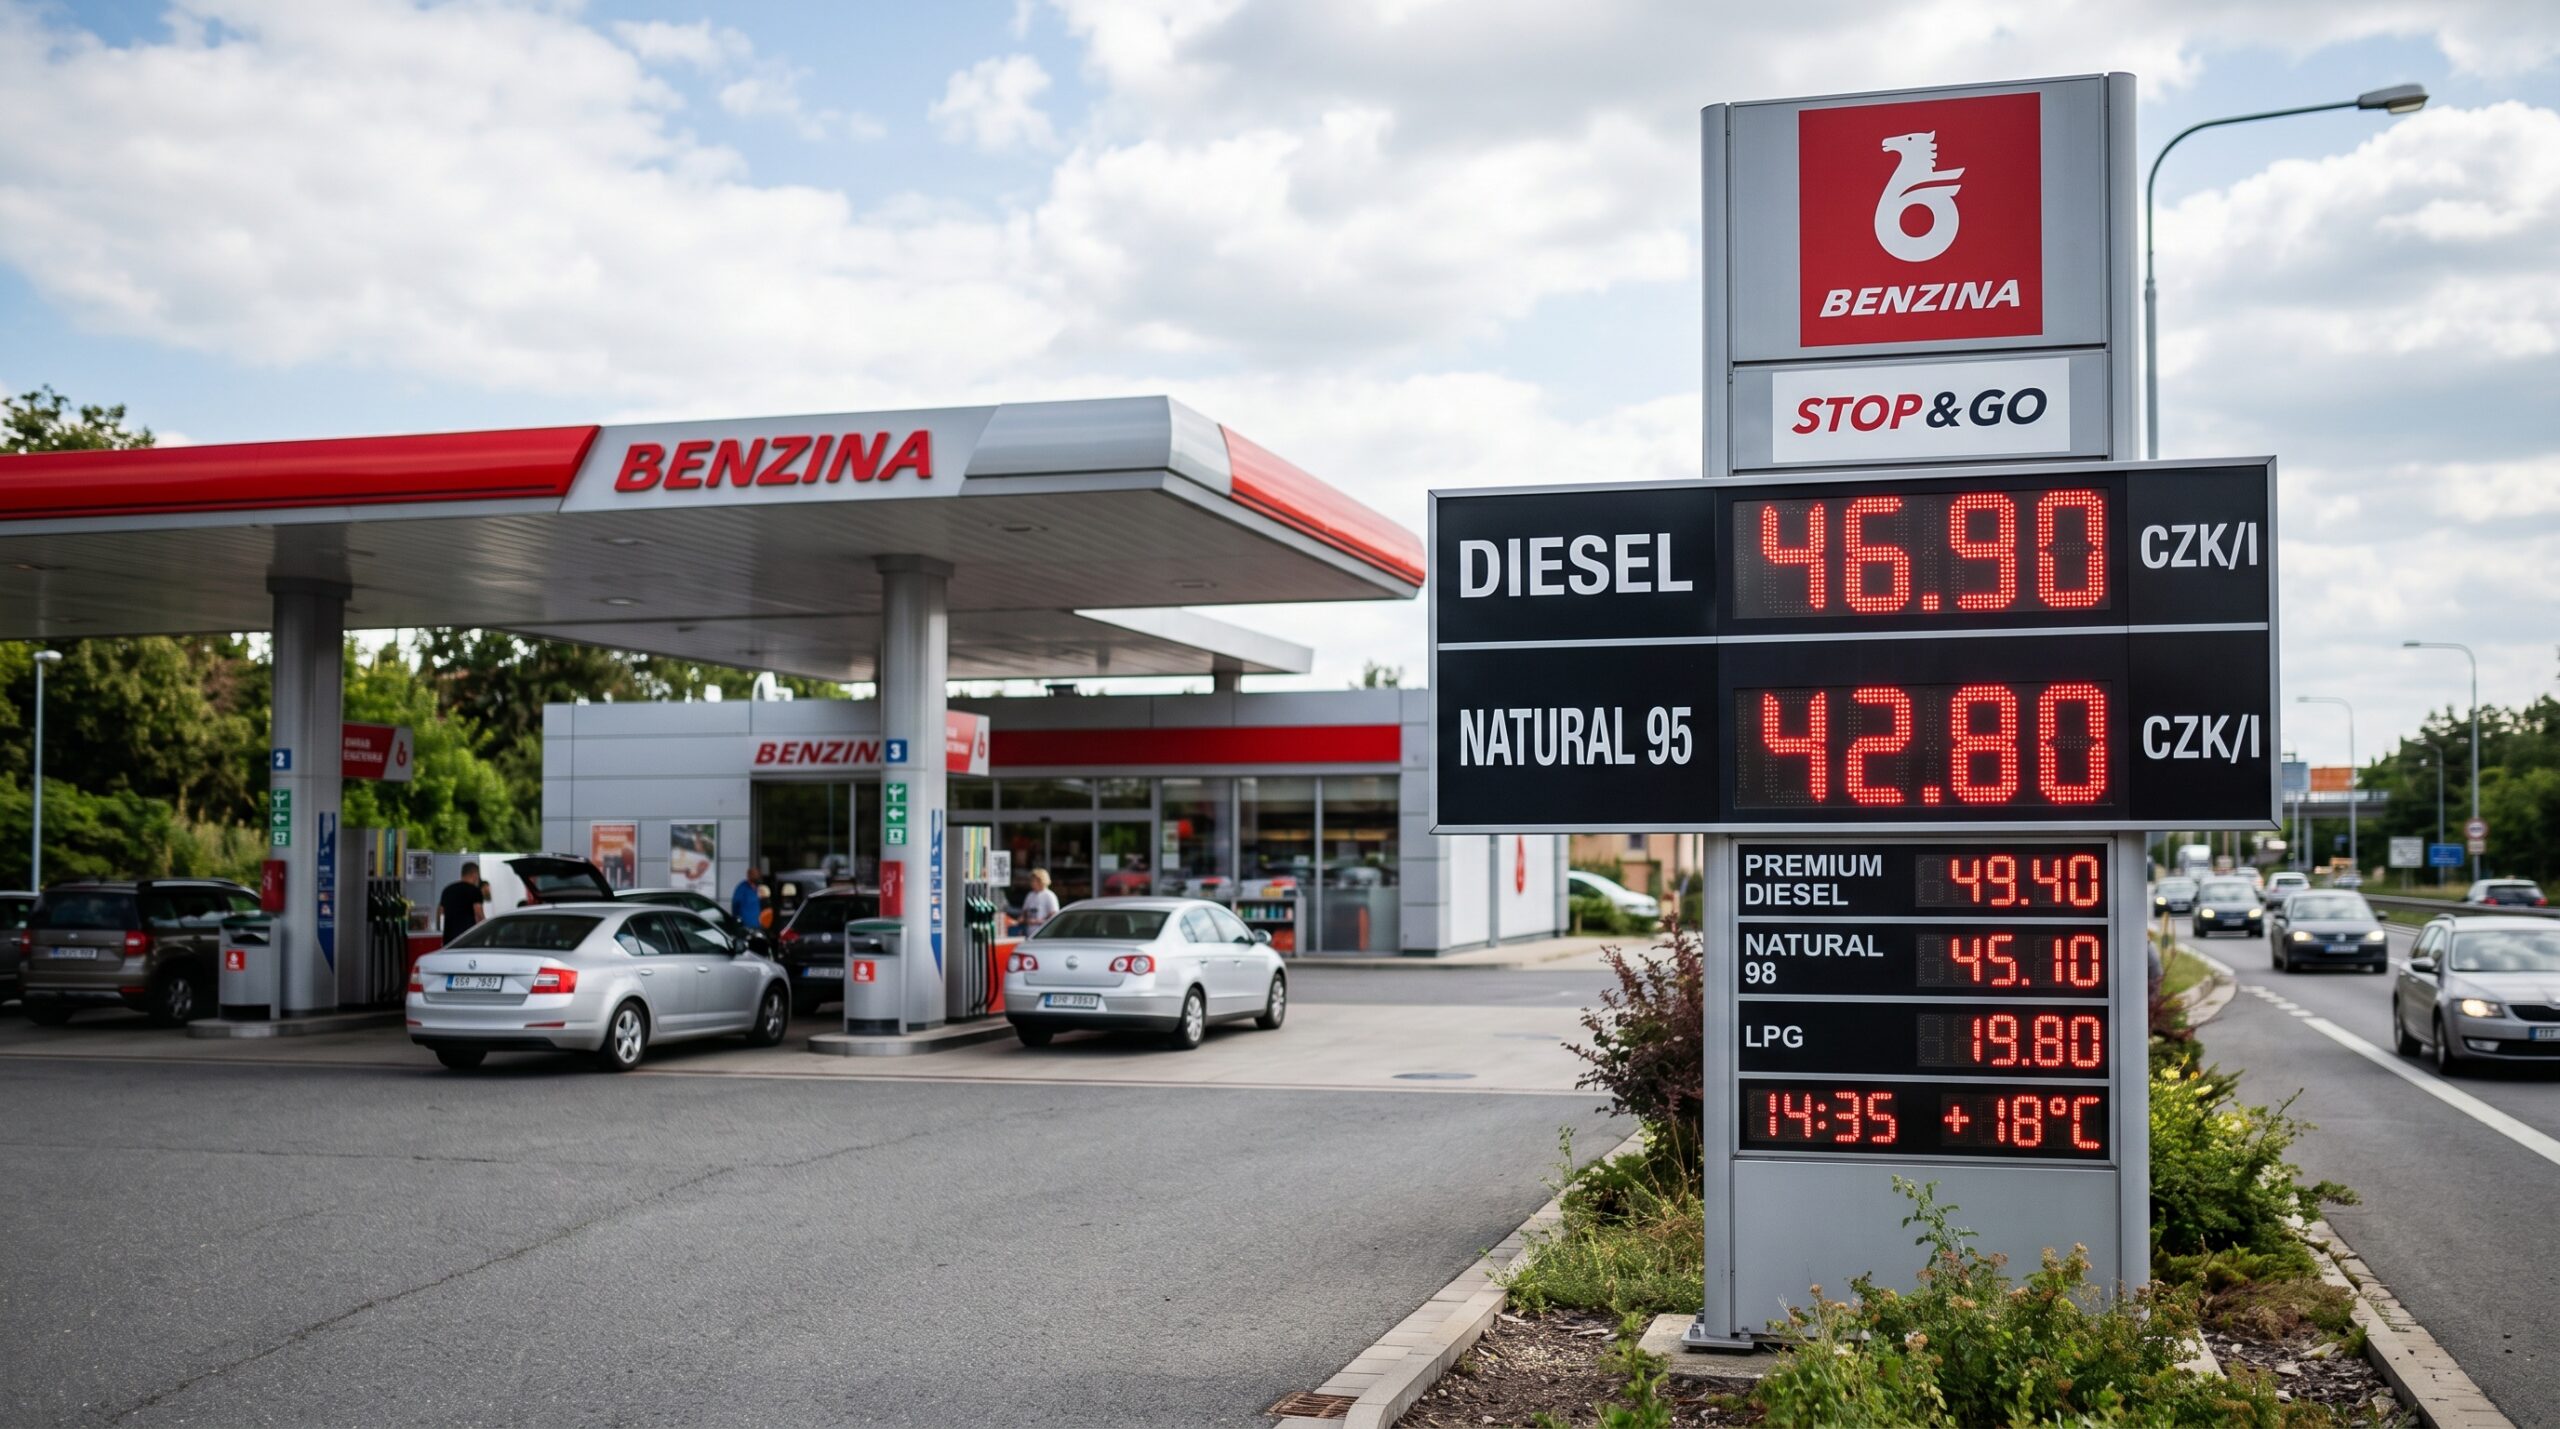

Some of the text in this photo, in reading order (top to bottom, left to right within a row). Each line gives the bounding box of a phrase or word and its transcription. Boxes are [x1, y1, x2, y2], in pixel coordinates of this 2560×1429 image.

[1819, 279, 2021, 318] BENZINA
[614, 429, 933, 493] BENZINA
[1459, 532, 1693, 598] DIESEL
[1763, 490, 2105, 612] 46.90
[275, 751, 285, 767] 2
[755, 741, 881, 765] BENZIN
[890, 743, 901, 760] 3
[1460, 706, 1693, 767] NATURAL 95
[1763, 684, 2106, 805] 42.80
[1745, 854, 1882, 877] PREMIUM
[1951, 855, 2099, 906] 49.40
[1745, 883, 1849, 906] DIESEL
[1745, 933, 1884, 957] NATURAL
[1951, 935, 2100, 987] 45.10
[1745, 961, 1777, 985] 98
[1746, 1025, 1803, 1049] LPG
[1972, 1015, 2100, 1067] 19.80
[1768, 1092, 1896, 1143] 14:35
